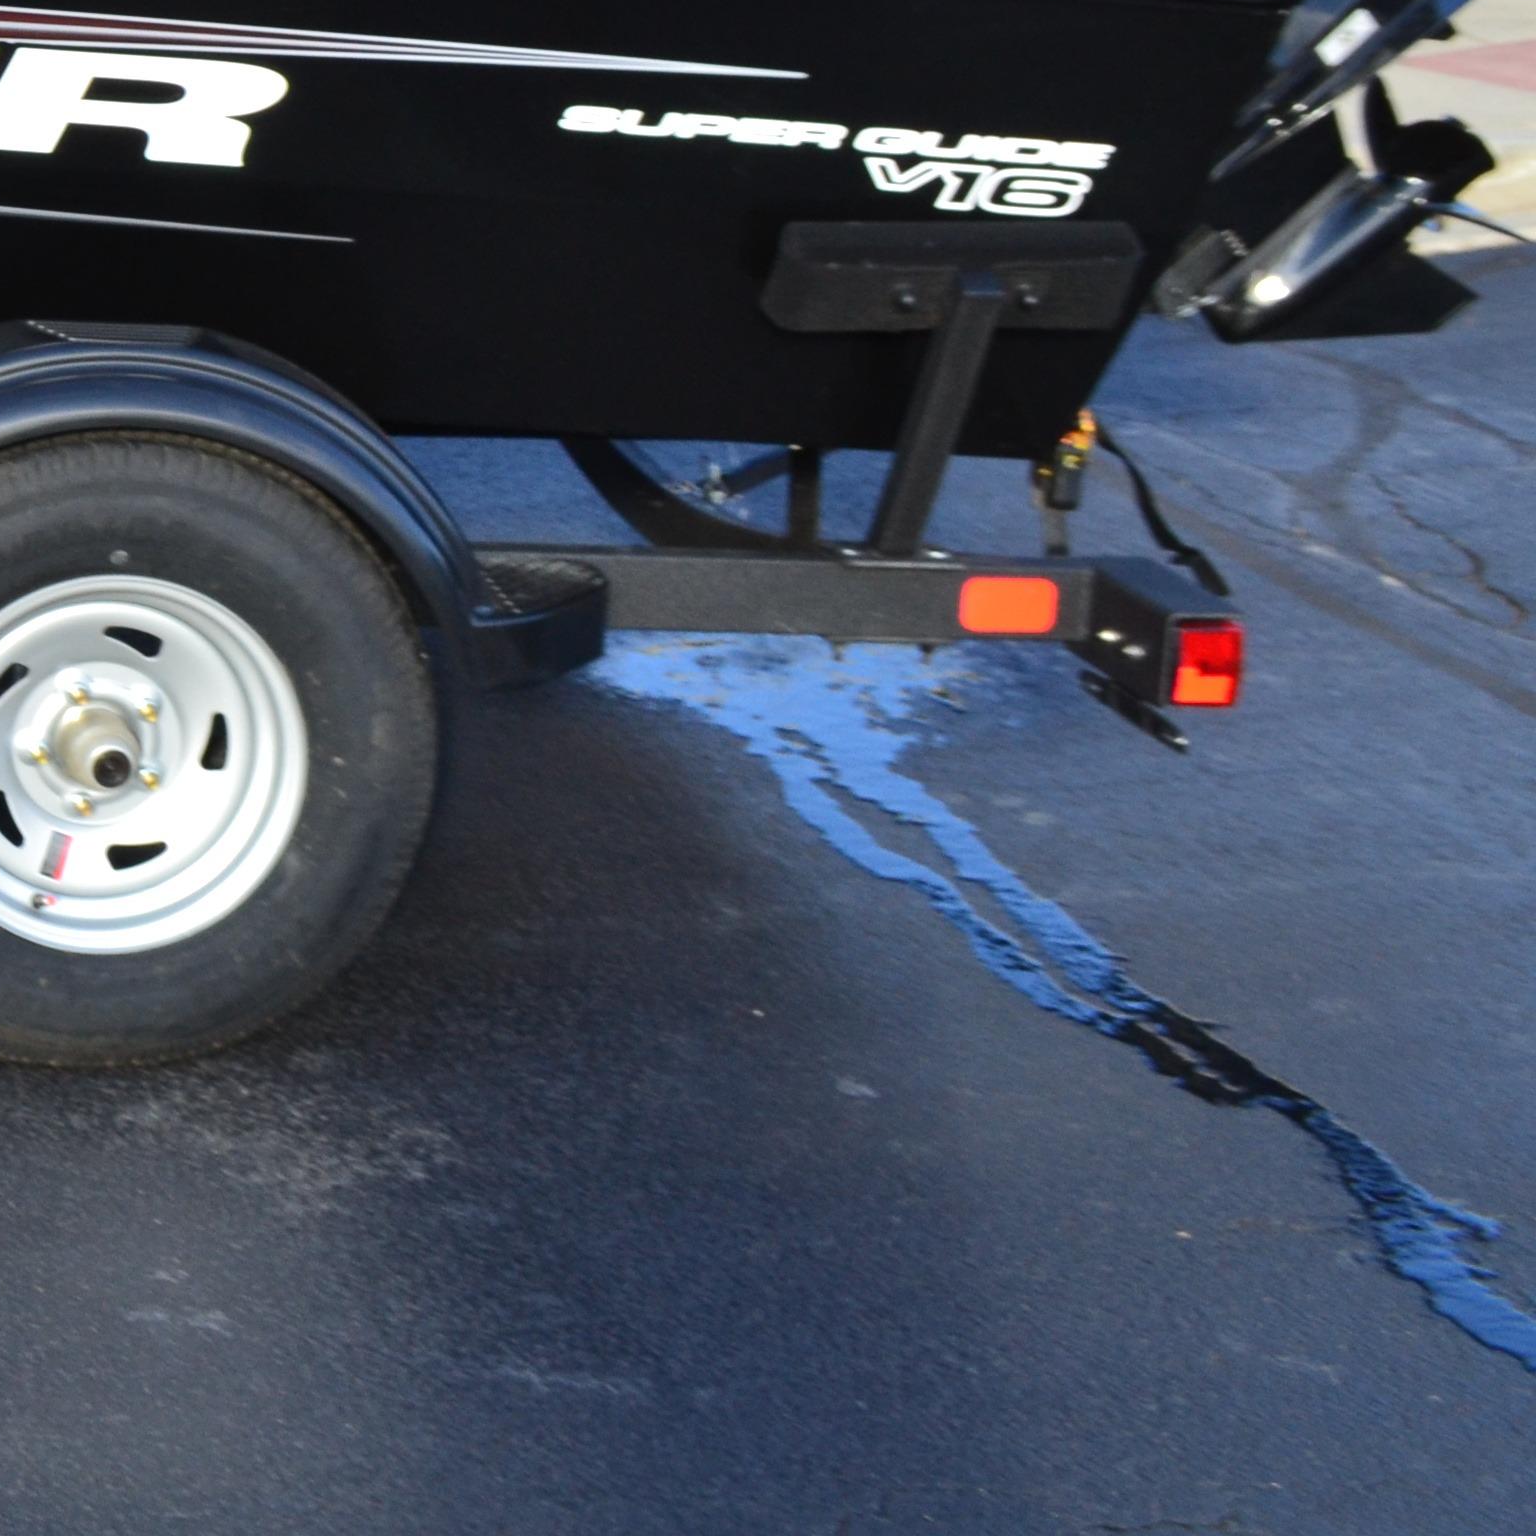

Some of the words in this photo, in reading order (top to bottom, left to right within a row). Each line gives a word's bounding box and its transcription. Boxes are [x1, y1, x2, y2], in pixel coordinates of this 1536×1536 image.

[557, 105, 848, 149] SUPER
[853, 126, 1117, 169] GUIDE
[863, 156, 1093, 217] V16
